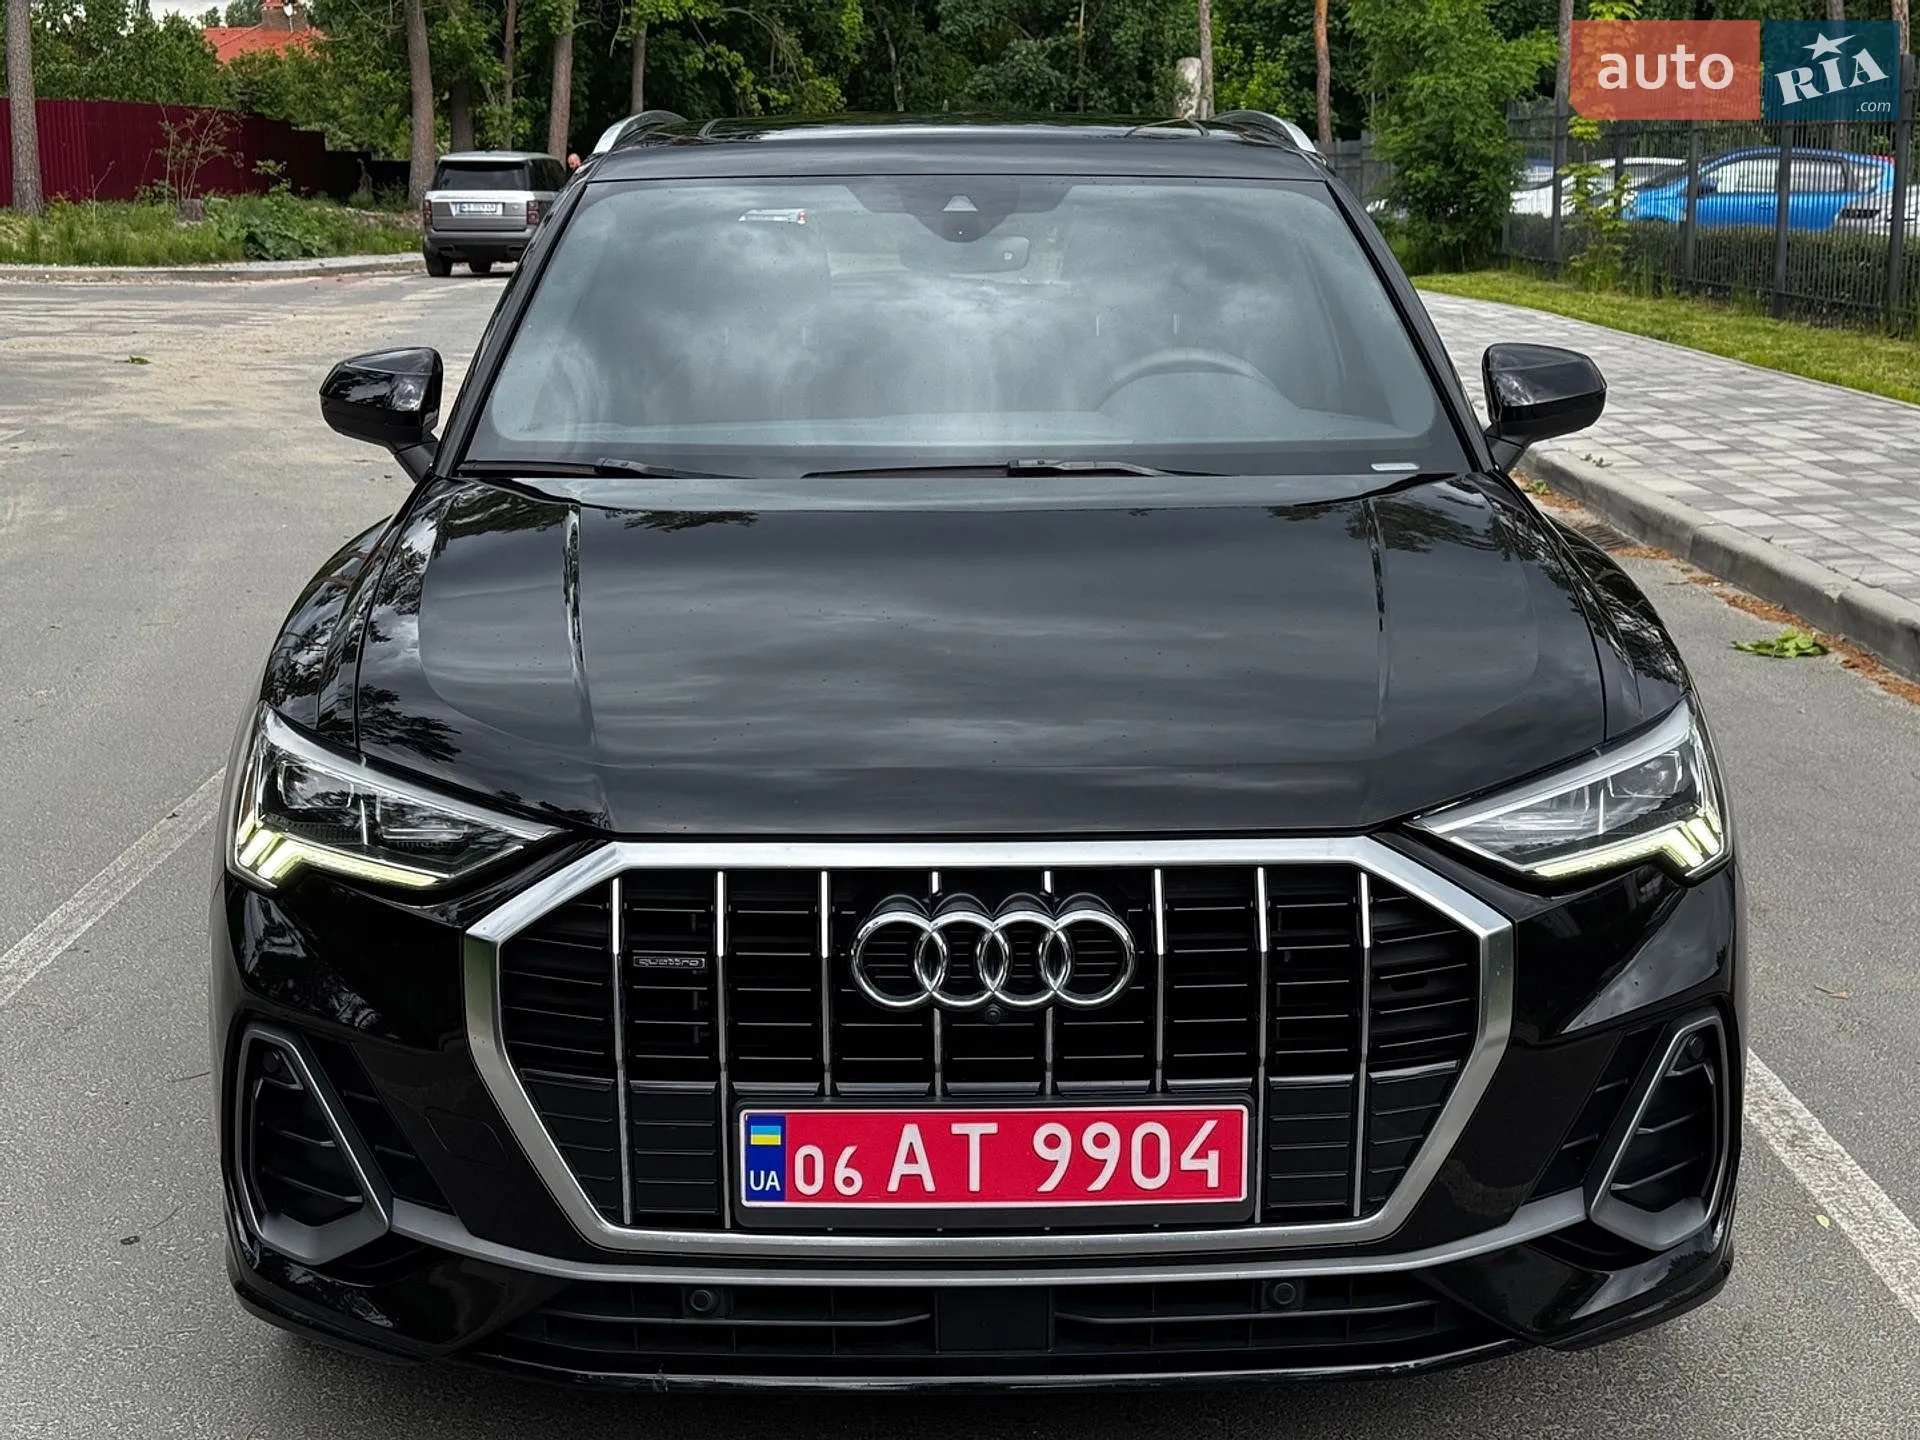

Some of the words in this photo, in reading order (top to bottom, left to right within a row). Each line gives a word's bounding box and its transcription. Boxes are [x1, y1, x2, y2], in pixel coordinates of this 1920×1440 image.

[638, 957, 700, 968] quattro
[793, 1144, 863, 1197] 06
[886, 1122, 999, 1193] AT
[1032, 1119, 1221, 1193] 9904
[749, 1169, 781, 1192] UA
